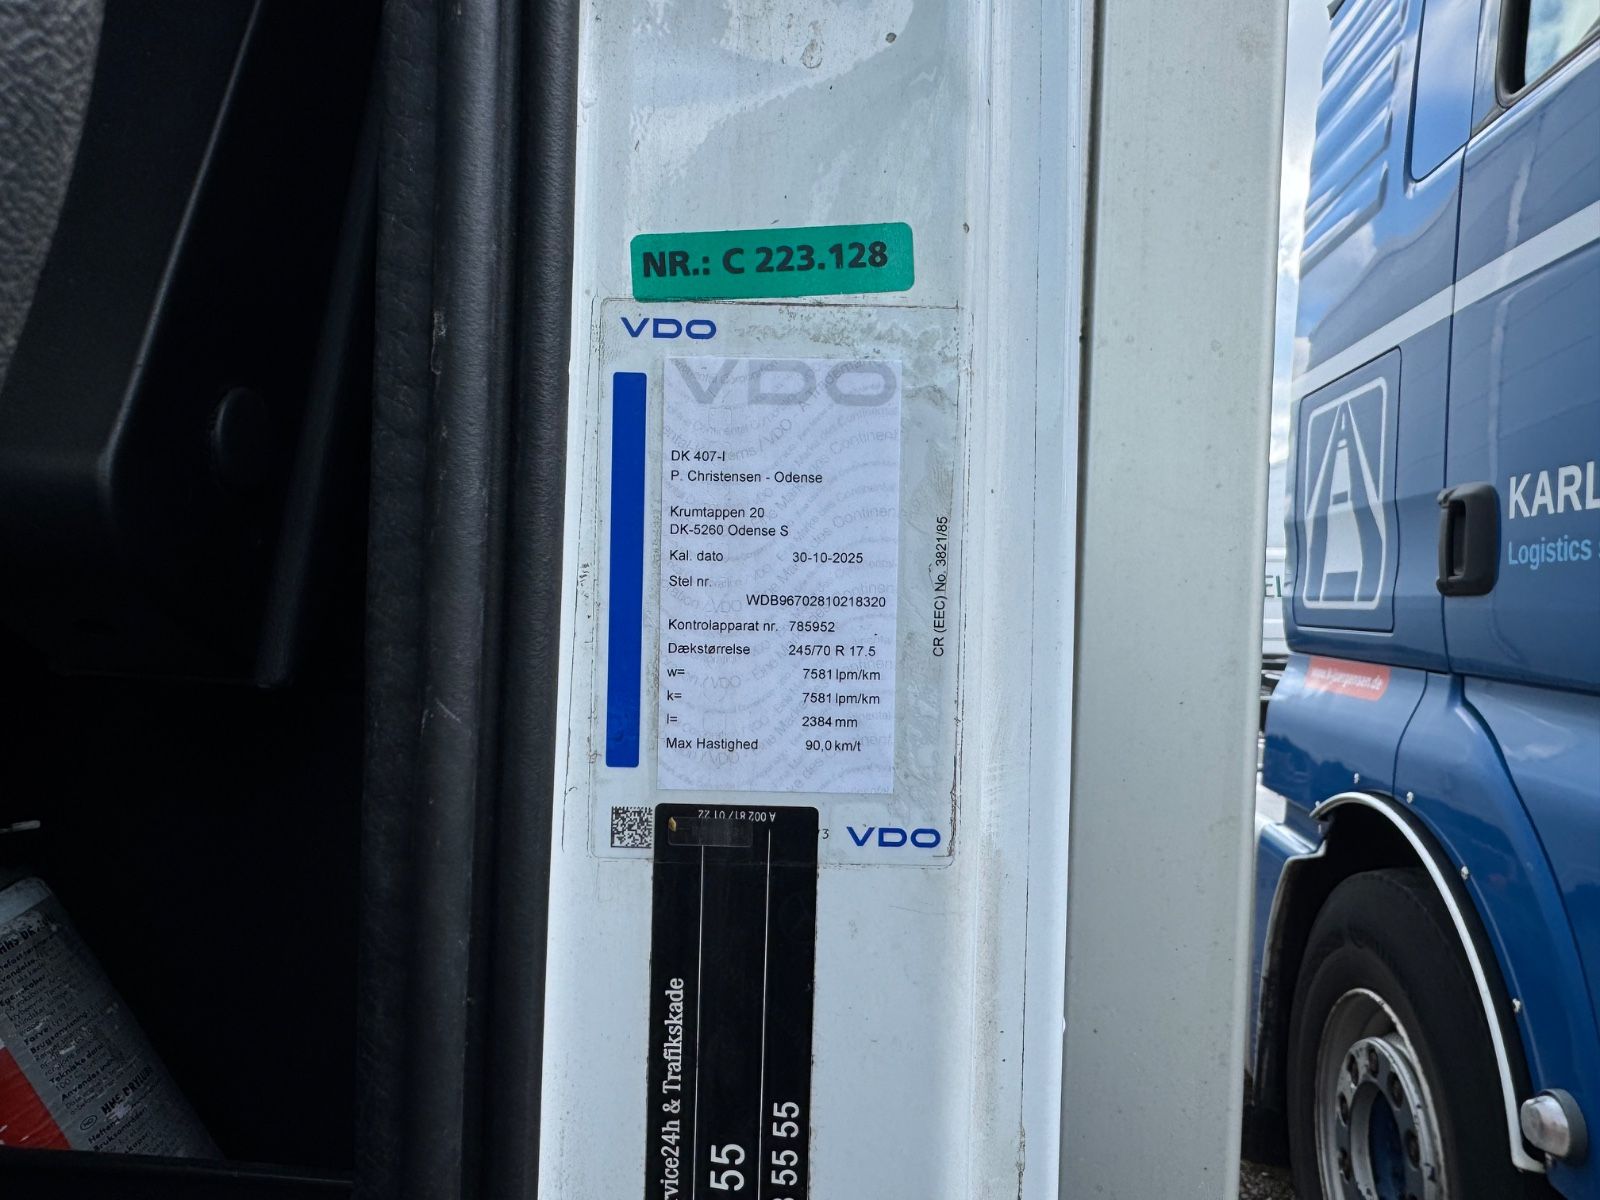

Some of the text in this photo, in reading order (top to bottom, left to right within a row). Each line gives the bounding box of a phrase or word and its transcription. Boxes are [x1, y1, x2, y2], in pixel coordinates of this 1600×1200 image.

[643, 241, 888, 278] NR.: C 223.128
[621, 317, 717, 339] VDO
[672, 450, 690, 462] DK
[670, 471, 684, 482] P.
[688, 470, 760, 482] Christensen
[774, 472, 822, 484] Odense
[1509, 461, 1600, 519] KARL
[670, 506, 764, 520] Krumtappen 20
[670, 524, 788, 536] DK-5260 Odense S
[669, 550, 864, 564] Kal. dato 30-10-2025
[1508, 534, 1592, 570] Logistics
[668, 576, 712, 586] Stel nr.
[932, 516, 948, 657] CR (EEC) No. 3821/85
[746, 594, 886, 608] WDB96702810218320
[668, 618, 834, 634] Kontrolapparat nr. 785952
[668, 642, 876, 656] Dækstørrelse 245/70 R 17.5
[666, 668, 684, 676] w=
[802, 668, 832, 680] 7581
[666, 690, 682, 700] k=
[802, 692, 832, 704] 7581
[802, 716, 832, 726] 2384
[836, 718, 858, 728] mm
[666, 738, 692, 748] Max
[696, 738, 758, 752] Hastighed
[834, 740, 860, 752] km/t
[847, 826, 941, 848] VDO
[663, 978, 684, 1093] Trafikskade
[663, 1099, 680, 1113] &
[773, 1101, 800, 1138] 55
[710, 1144, 745, 1191] 55
[771, 1150, 798, 1186] 55
